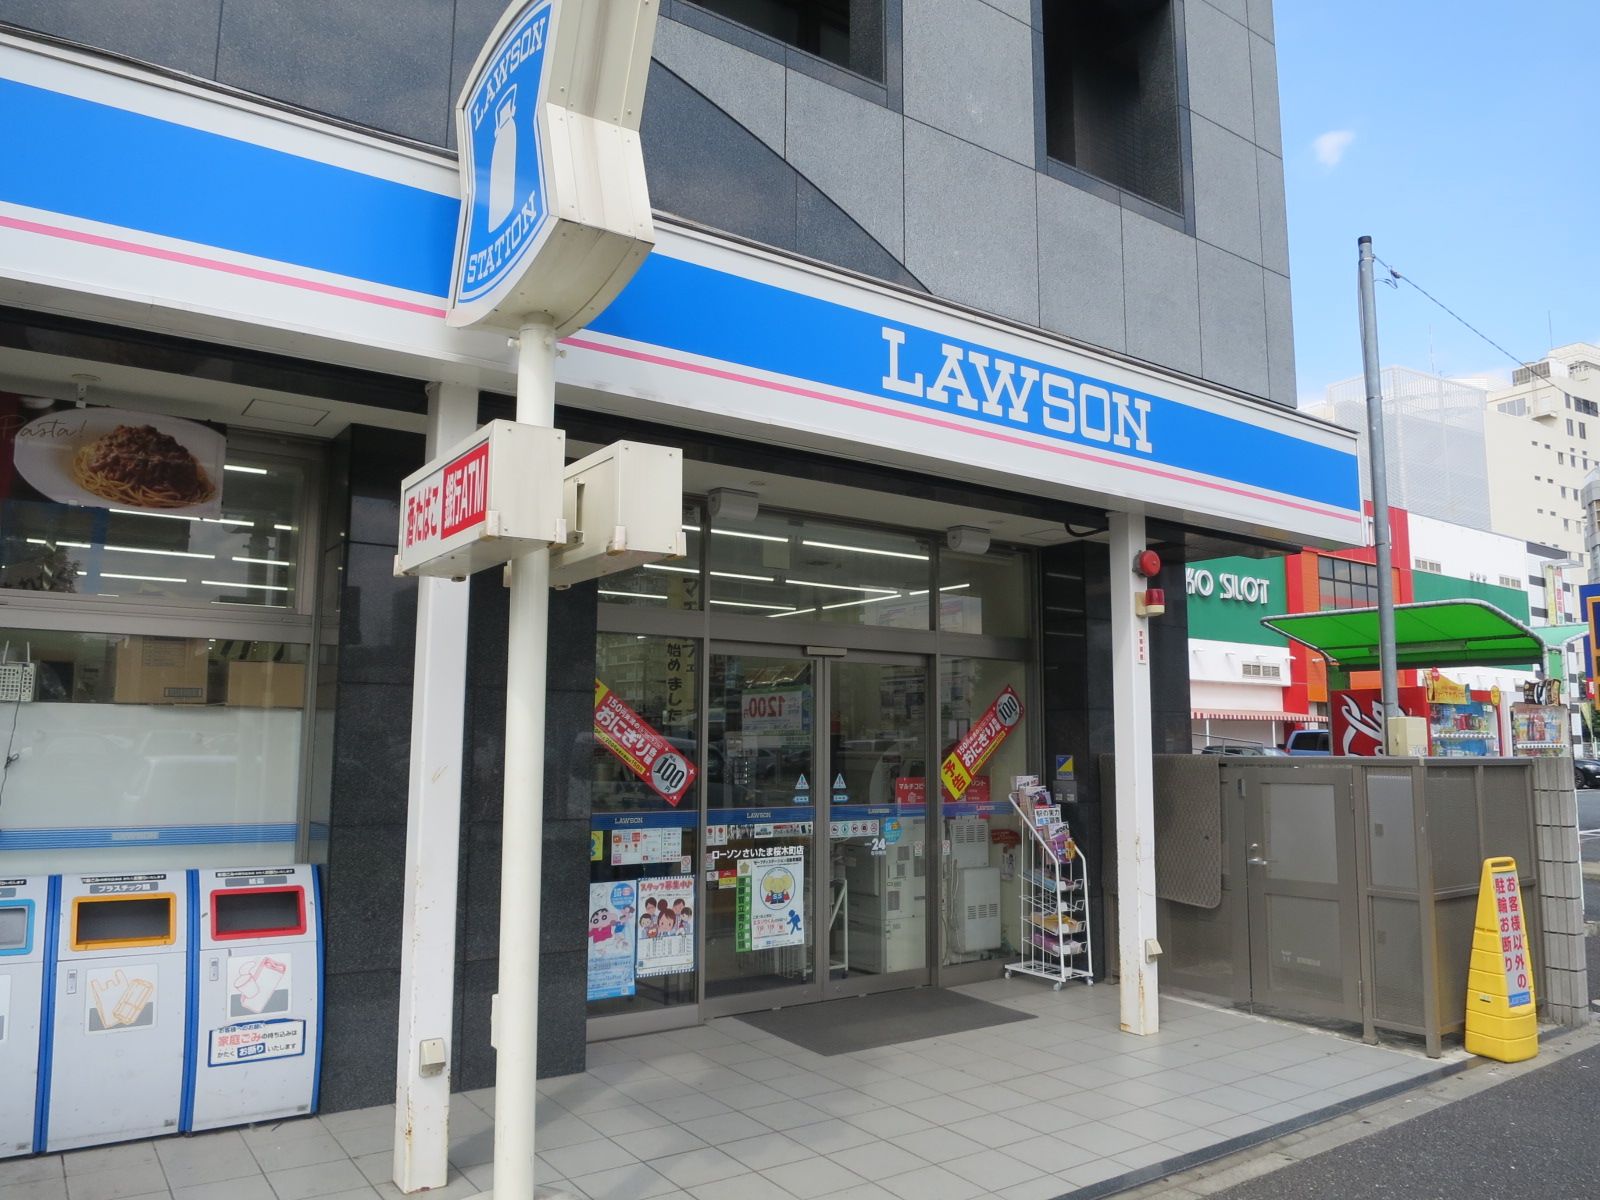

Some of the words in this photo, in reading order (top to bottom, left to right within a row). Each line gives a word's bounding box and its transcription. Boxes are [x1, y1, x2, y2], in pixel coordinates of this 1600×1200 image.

[475, 17, 546, 130] LAWSON
[467, 190, 537, 283] STATION
[881, 326, 1153, 453] LAWSON
[444, 455, 486, 530] 銀行ATM
[1219, 572, 1270, 605] SLOT
[667, 642, 683, 723] 始めました
[998, 695, 1018, 723] 100
[653, 757, 685, 789] 100
[943, 760, 967, 793] 予告
[614, 817, 643, 825] LAWSON
[871, 838, 886, 851] 24
[712, 845, 804, 859] ローソンさいたま桜木町店
[1494, 878, 1513, 973] 駐輪お断り
[1507, 877, 1527, 989] お客様以外の
